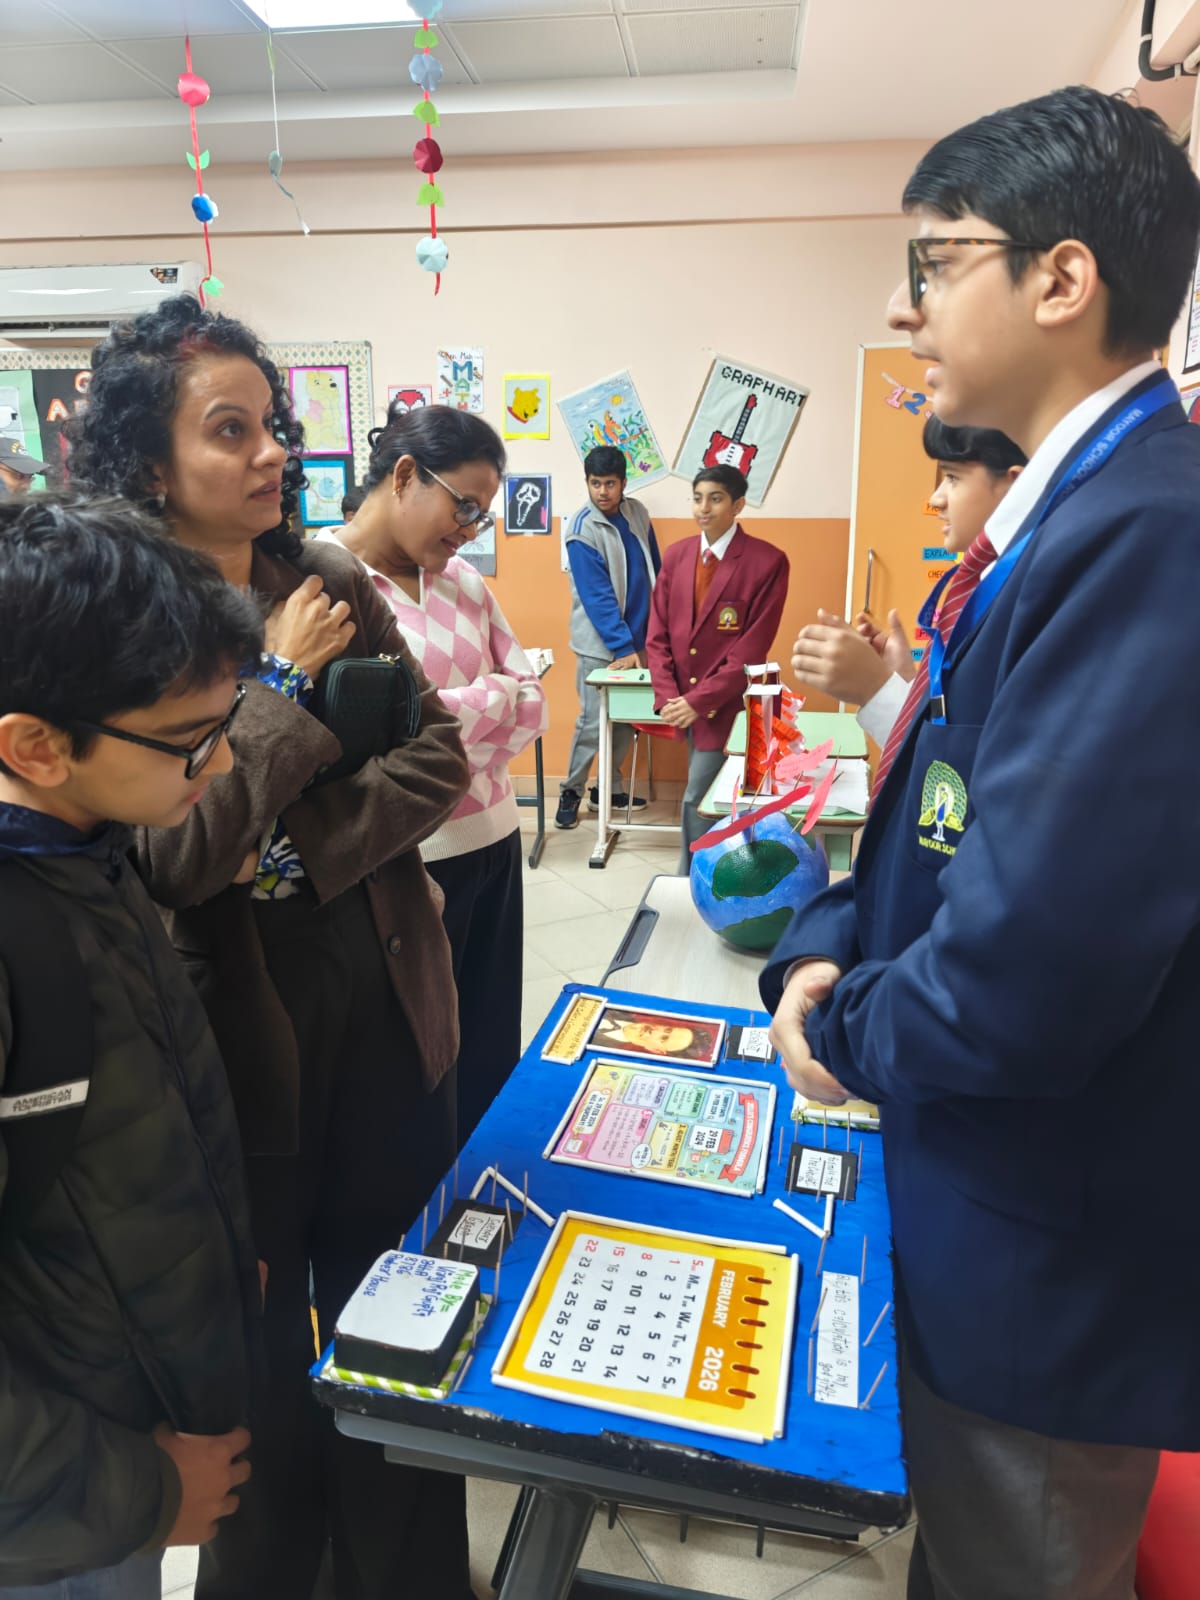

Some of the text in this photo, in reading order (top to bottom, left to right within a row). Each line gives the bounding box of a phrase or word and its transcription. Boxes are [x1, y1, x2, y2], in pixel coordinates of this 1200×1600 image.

[721, 366, 775, 396] GRAPH
[14, 1088, 72, 1106] AMERICAN
[694, 1131, 705, 1145] 2024
[705, 1130, 718, 1149] 29 FEB
[664, 1274, 677, 1282] 2
[539, 1239, 599, 1369] 22 23 24 25 26 27 28
[659, 1292, 672, 1301] 3
[712, 1269, 735, 1328] FEBRUARY
[571, 1246, 625, 1373] 15 16 17 18 19 20 21
[603, 1252, 653, 1378] 8 9 10 11 12 13 14
[653, 1311, 666, 1319] 4
[648, 1331, 661, 1340] 5
[642, 1352, 656, 1361] 6
[698, 1346, 723, 1391] 2026
[636, 1375, 650, 1383] 7
